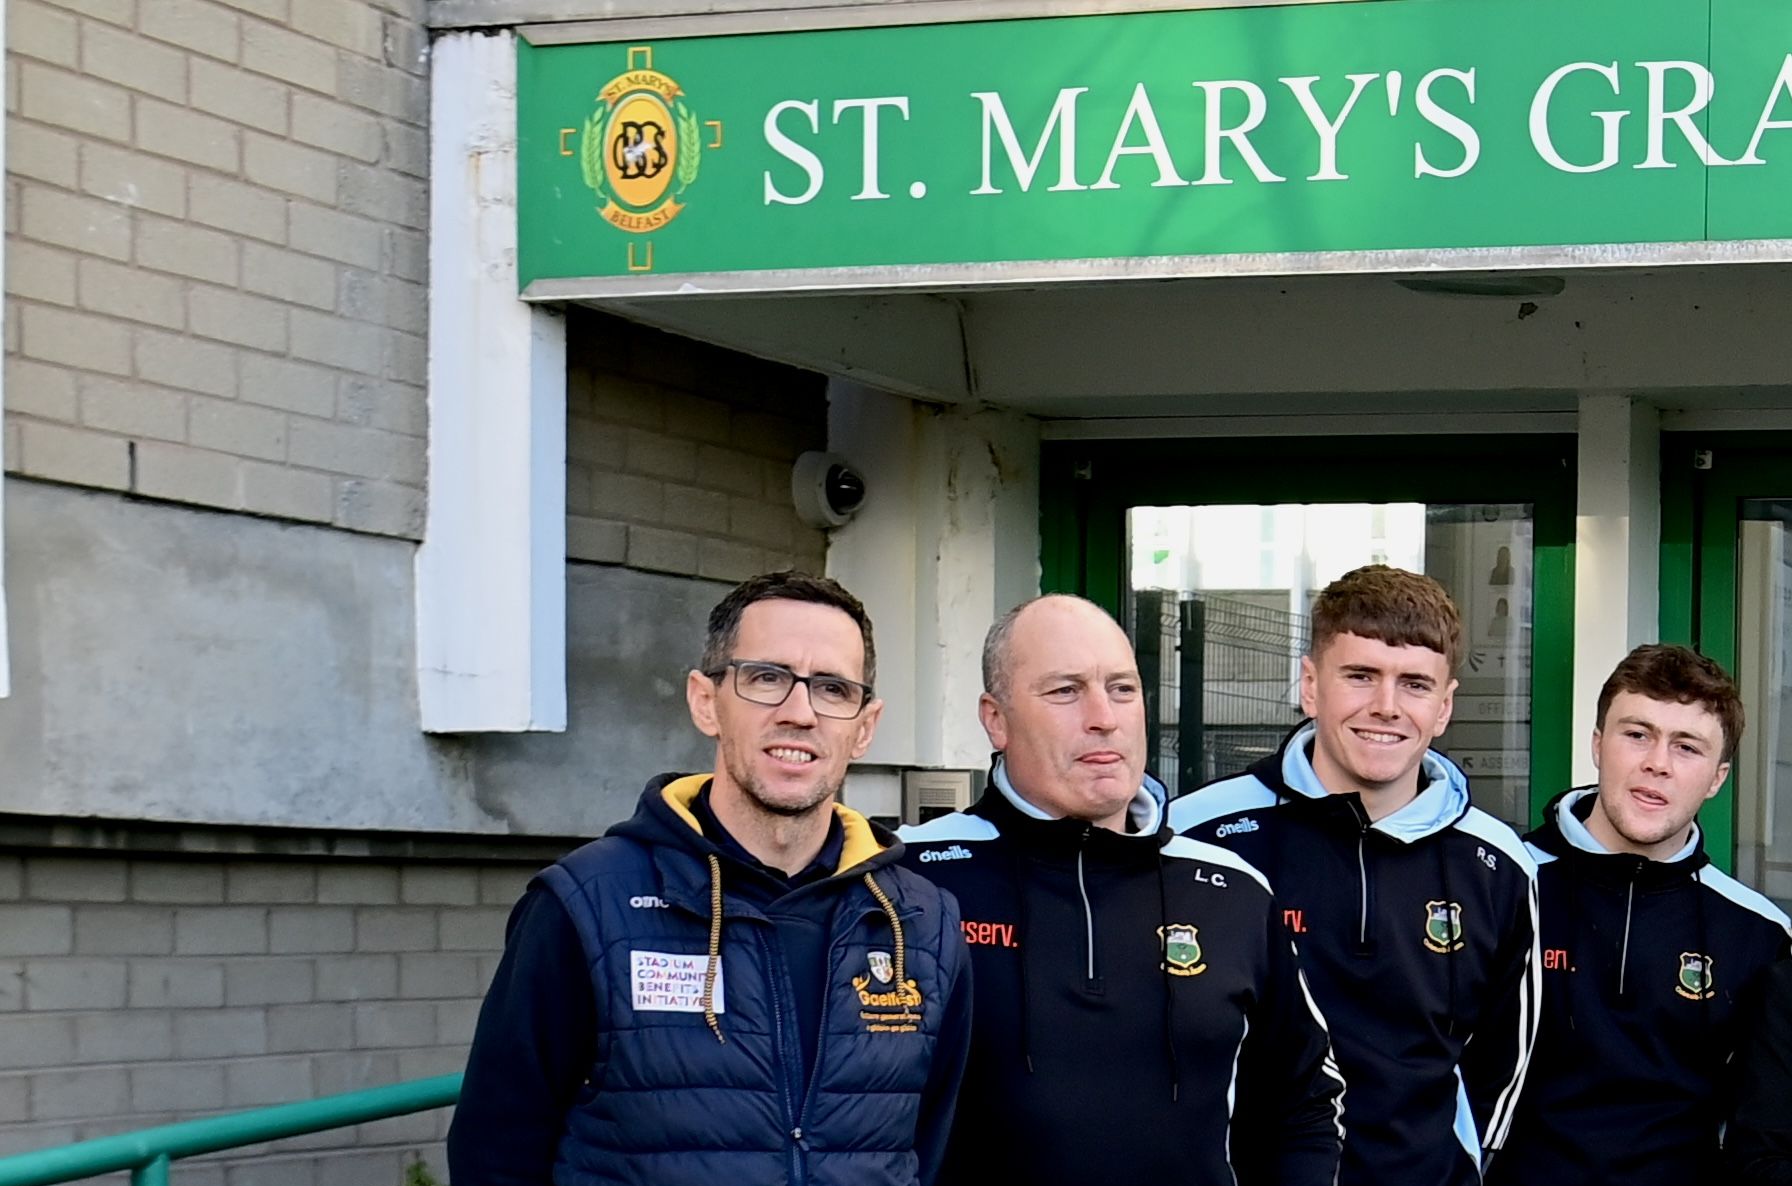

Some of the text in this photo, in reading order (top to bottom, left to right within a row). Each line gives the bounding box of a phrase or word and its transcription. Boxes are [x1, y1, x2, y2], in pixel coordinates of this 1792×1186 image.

[765, 97, 925, 204] ST.
[972, 66, 1479, 194] MARY'S
[611, 209, 670, 230] BELFAST
